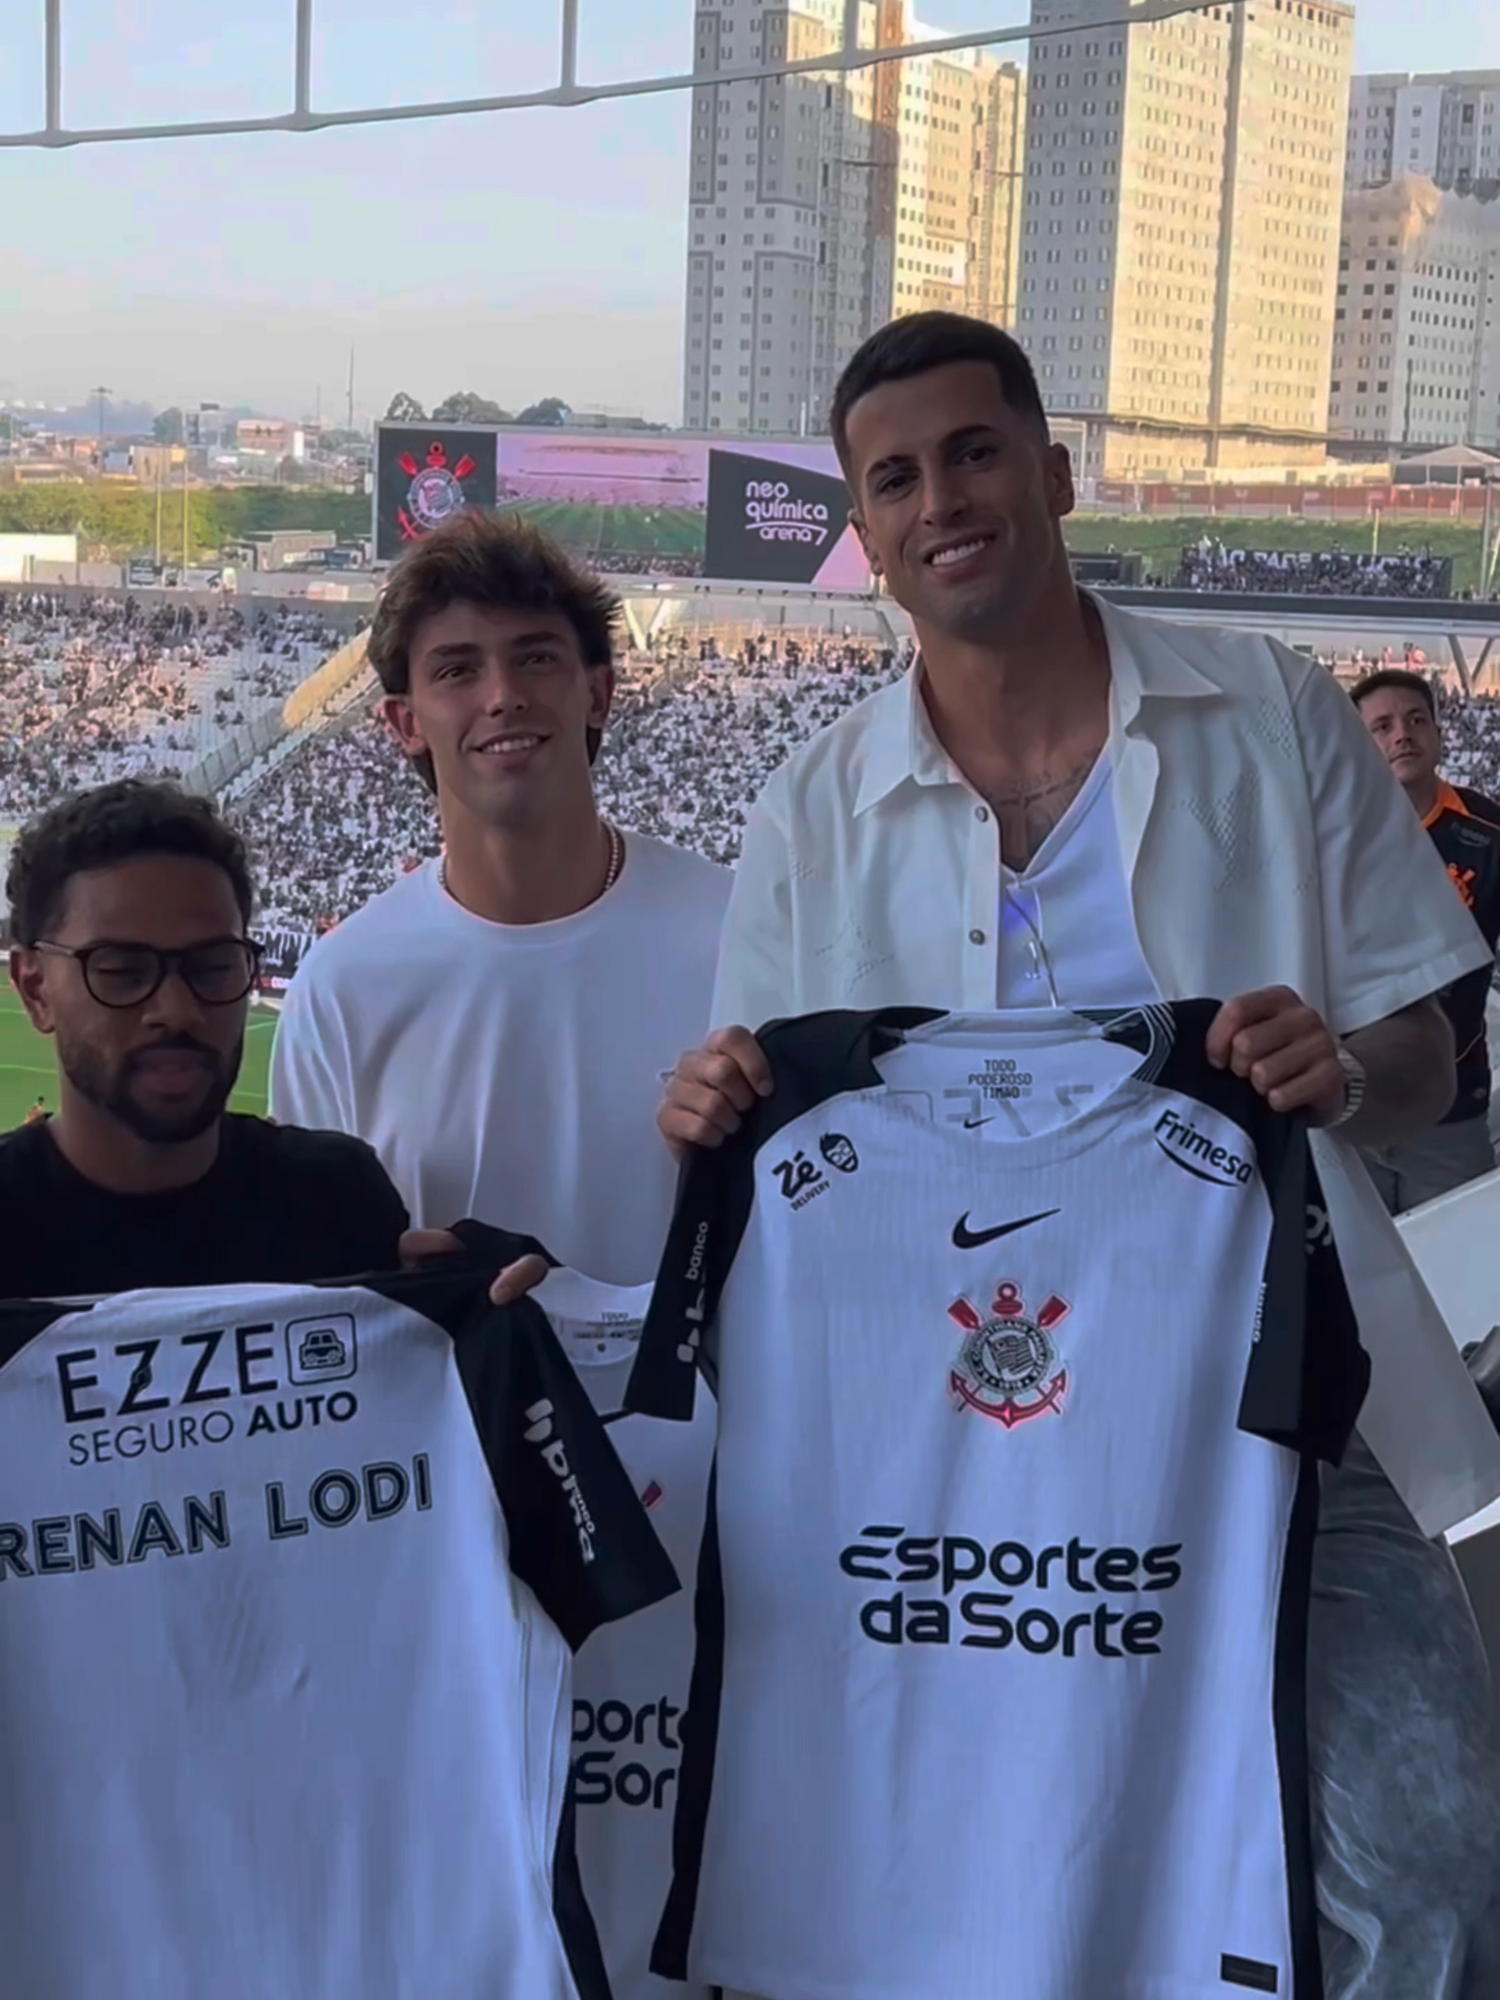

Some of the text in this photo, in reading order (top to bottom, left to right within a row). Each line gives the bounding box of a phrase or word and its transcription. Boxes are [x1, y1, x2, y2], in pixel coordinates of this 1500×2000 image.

[746, 481, 789, 499] neo
[760, 526, 812, 542] arena
[968, 1073, 1032, 1086] PODEROSO
[1154, 1109, 1253, 1184] Frimesa
[771, 1150, 823, 1200] Zé
[684, 1221, 708, 1280] banco
[56, 1322, 279, 1424] EZZE
[68, 1410, 234, 1466] SEGURO
[246, 1391, 358, 1436] AUTO
[0, 1453, 433, 1581] RENAN LODI
[838, 1525, 1183, 1596] Esportes
